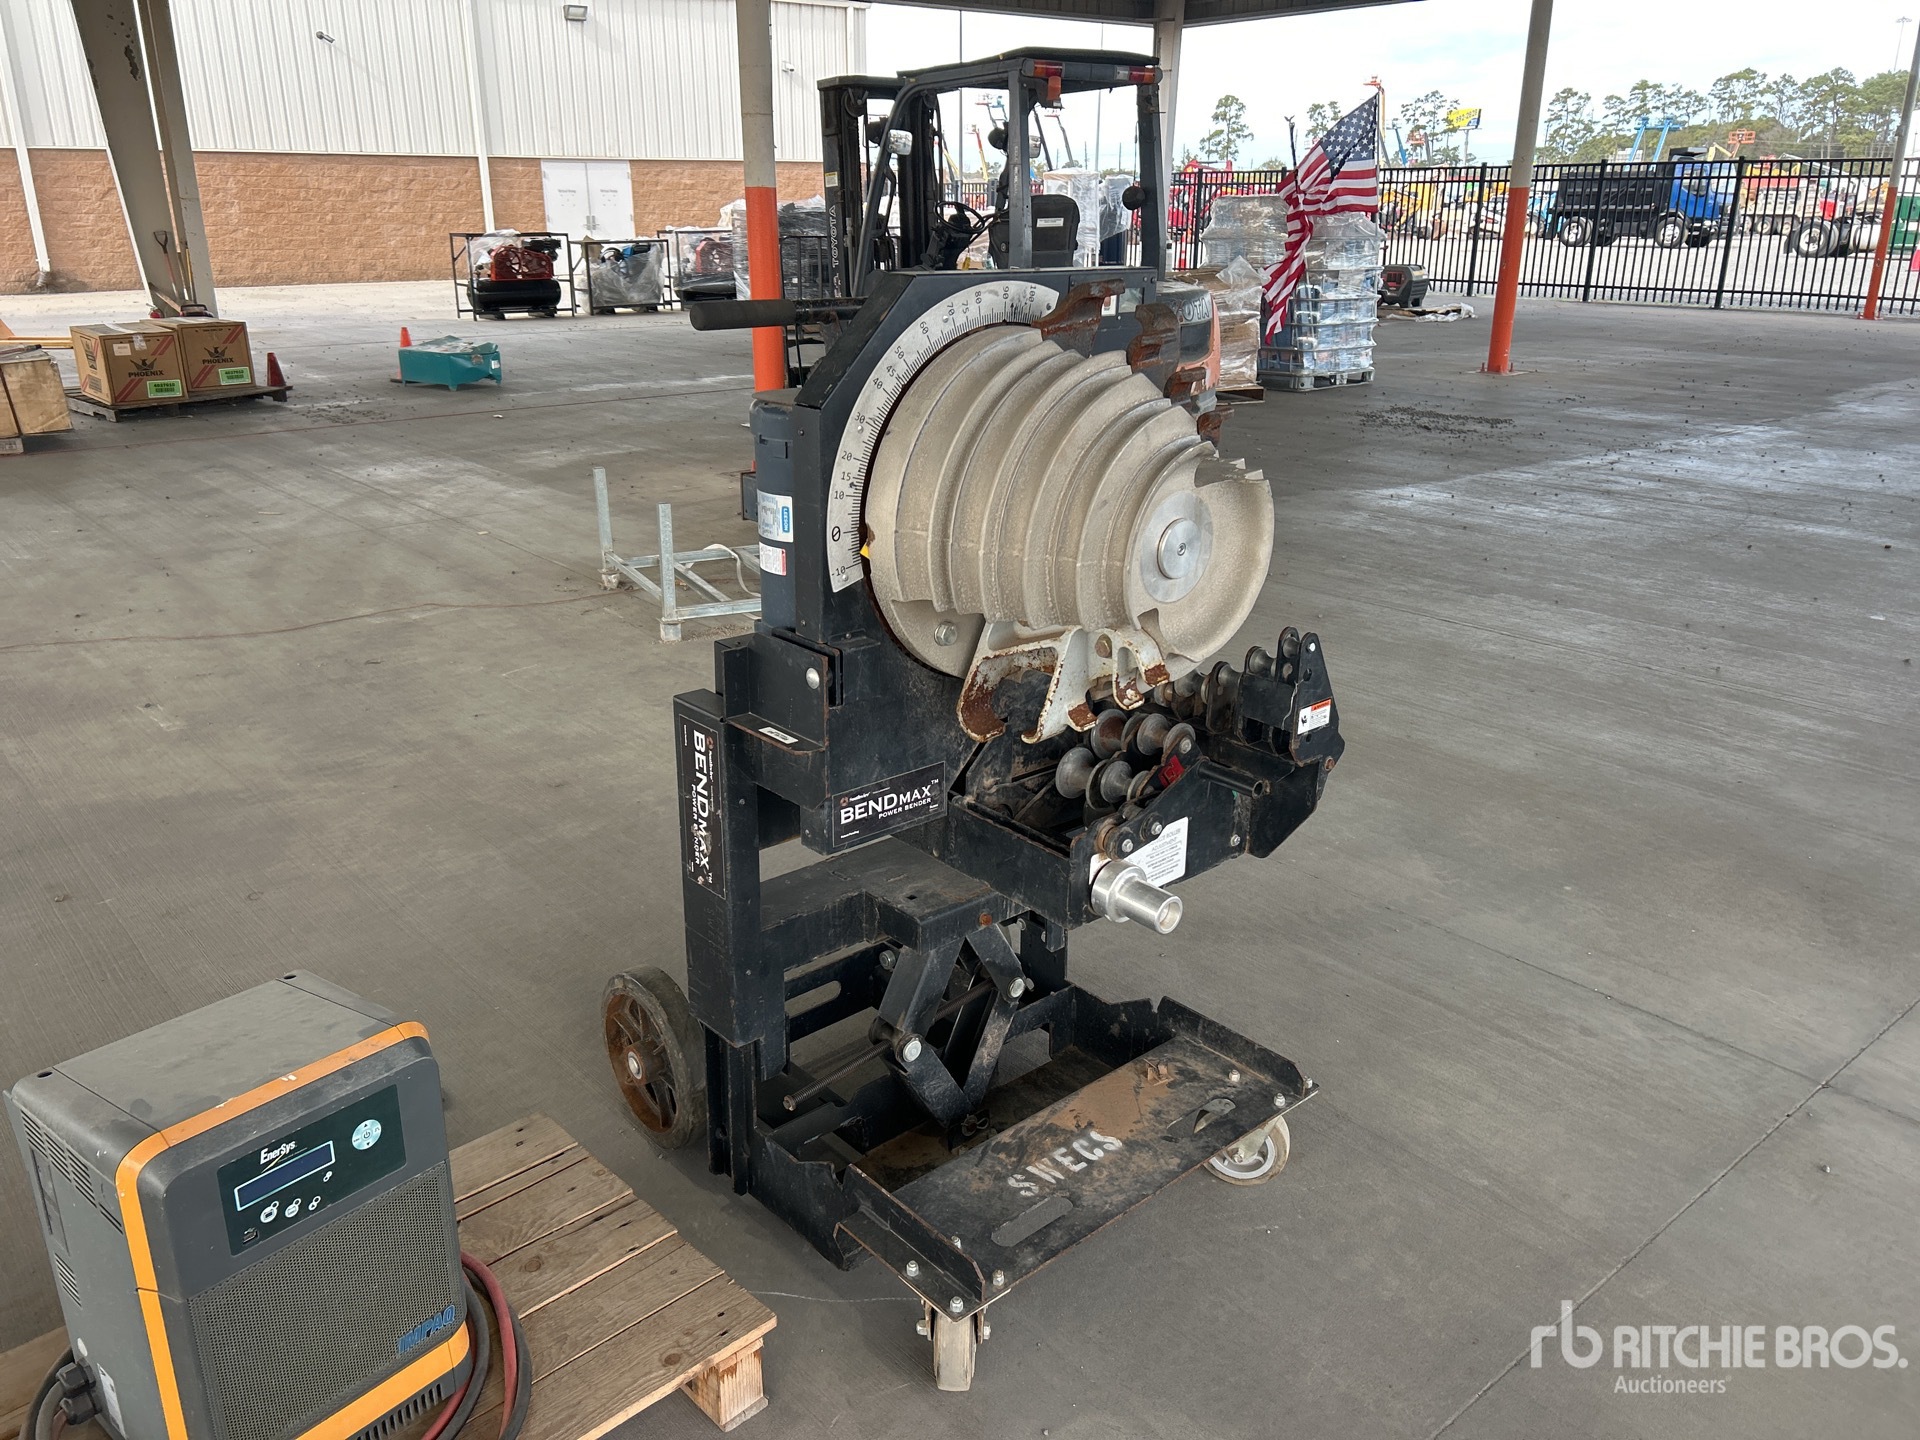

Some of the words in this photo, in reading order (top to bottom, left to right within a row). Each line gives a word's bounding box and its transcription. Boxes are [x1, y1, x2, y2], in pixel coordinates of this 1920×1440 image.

[829, 205, 839, 268] TOYOTA
[974, 290, 983, 305] 80
[1002, 285, 1010, 300] 90
[1028, 284, 1037, 303] 100
[946, 301, 956, 317] 70
[961, 299, 970, 315] 75
[919, 320, 929, 335] 60
[894, 345, 905, 360] 50
[202, 357, 234, 365] PHOENIX
[128, 370, 165, 378] PHOENIX
[886, 365, 897, 378] 45
[872, 378, 884, 389] 40
[854, 411, 866, 424] 30
[841, 450, 853, 462] 20
[841, 471, 851, 481] 15
[834, 490, 845, 500] 10
[831, 565, 846, 577] -10
[878, 807, 903, 819] POWER
[904, 797, 932, 811] BENDER
[260, 1140, 296, 1165] EnerSys
[1007, 1131, 1123, 1197] SWECS
[398, 1304, 456, 1355] IMPAQ
